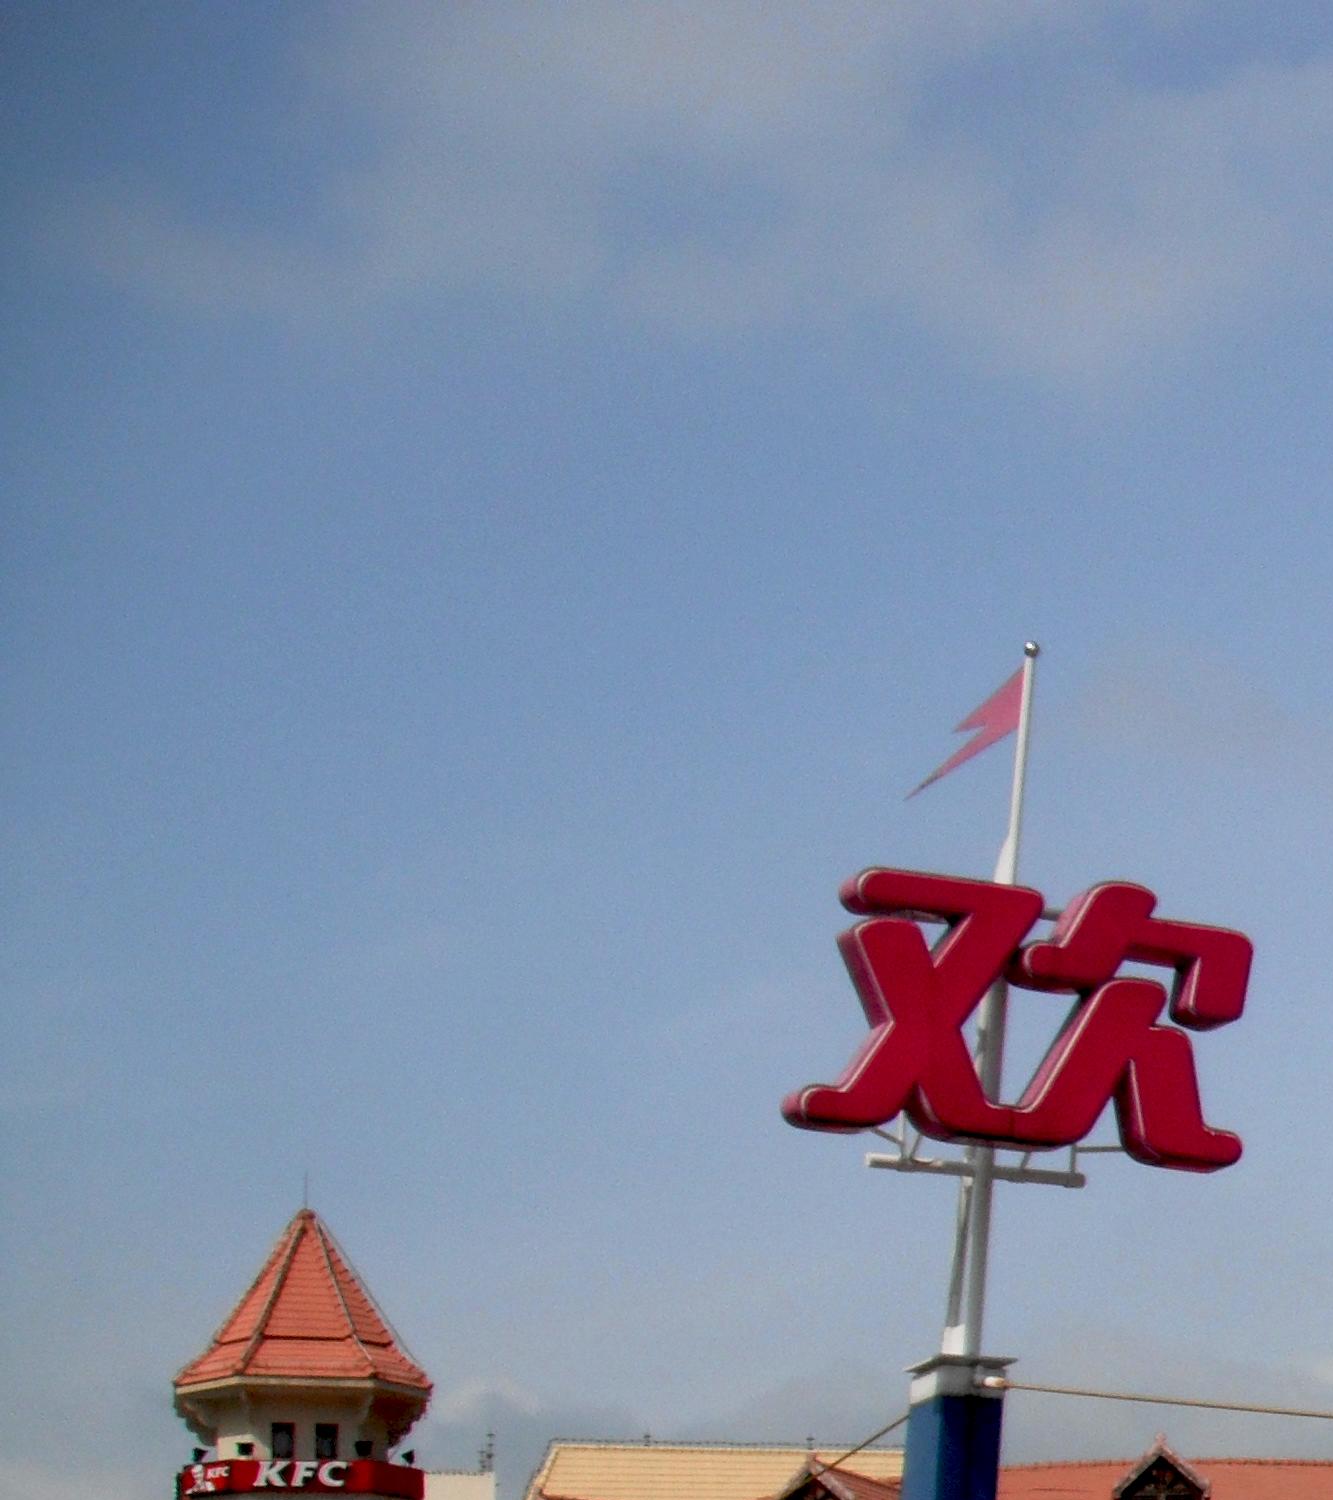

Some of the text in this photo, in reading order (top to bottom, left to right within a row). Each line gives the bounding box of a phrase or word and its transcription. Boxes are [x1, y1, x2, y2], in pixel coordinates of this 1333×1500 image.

[781, 866, 1254, 1173] 欢
[207, 1466, 230, 1478] KFC
[254, 1461, 348, 1487] KFC
